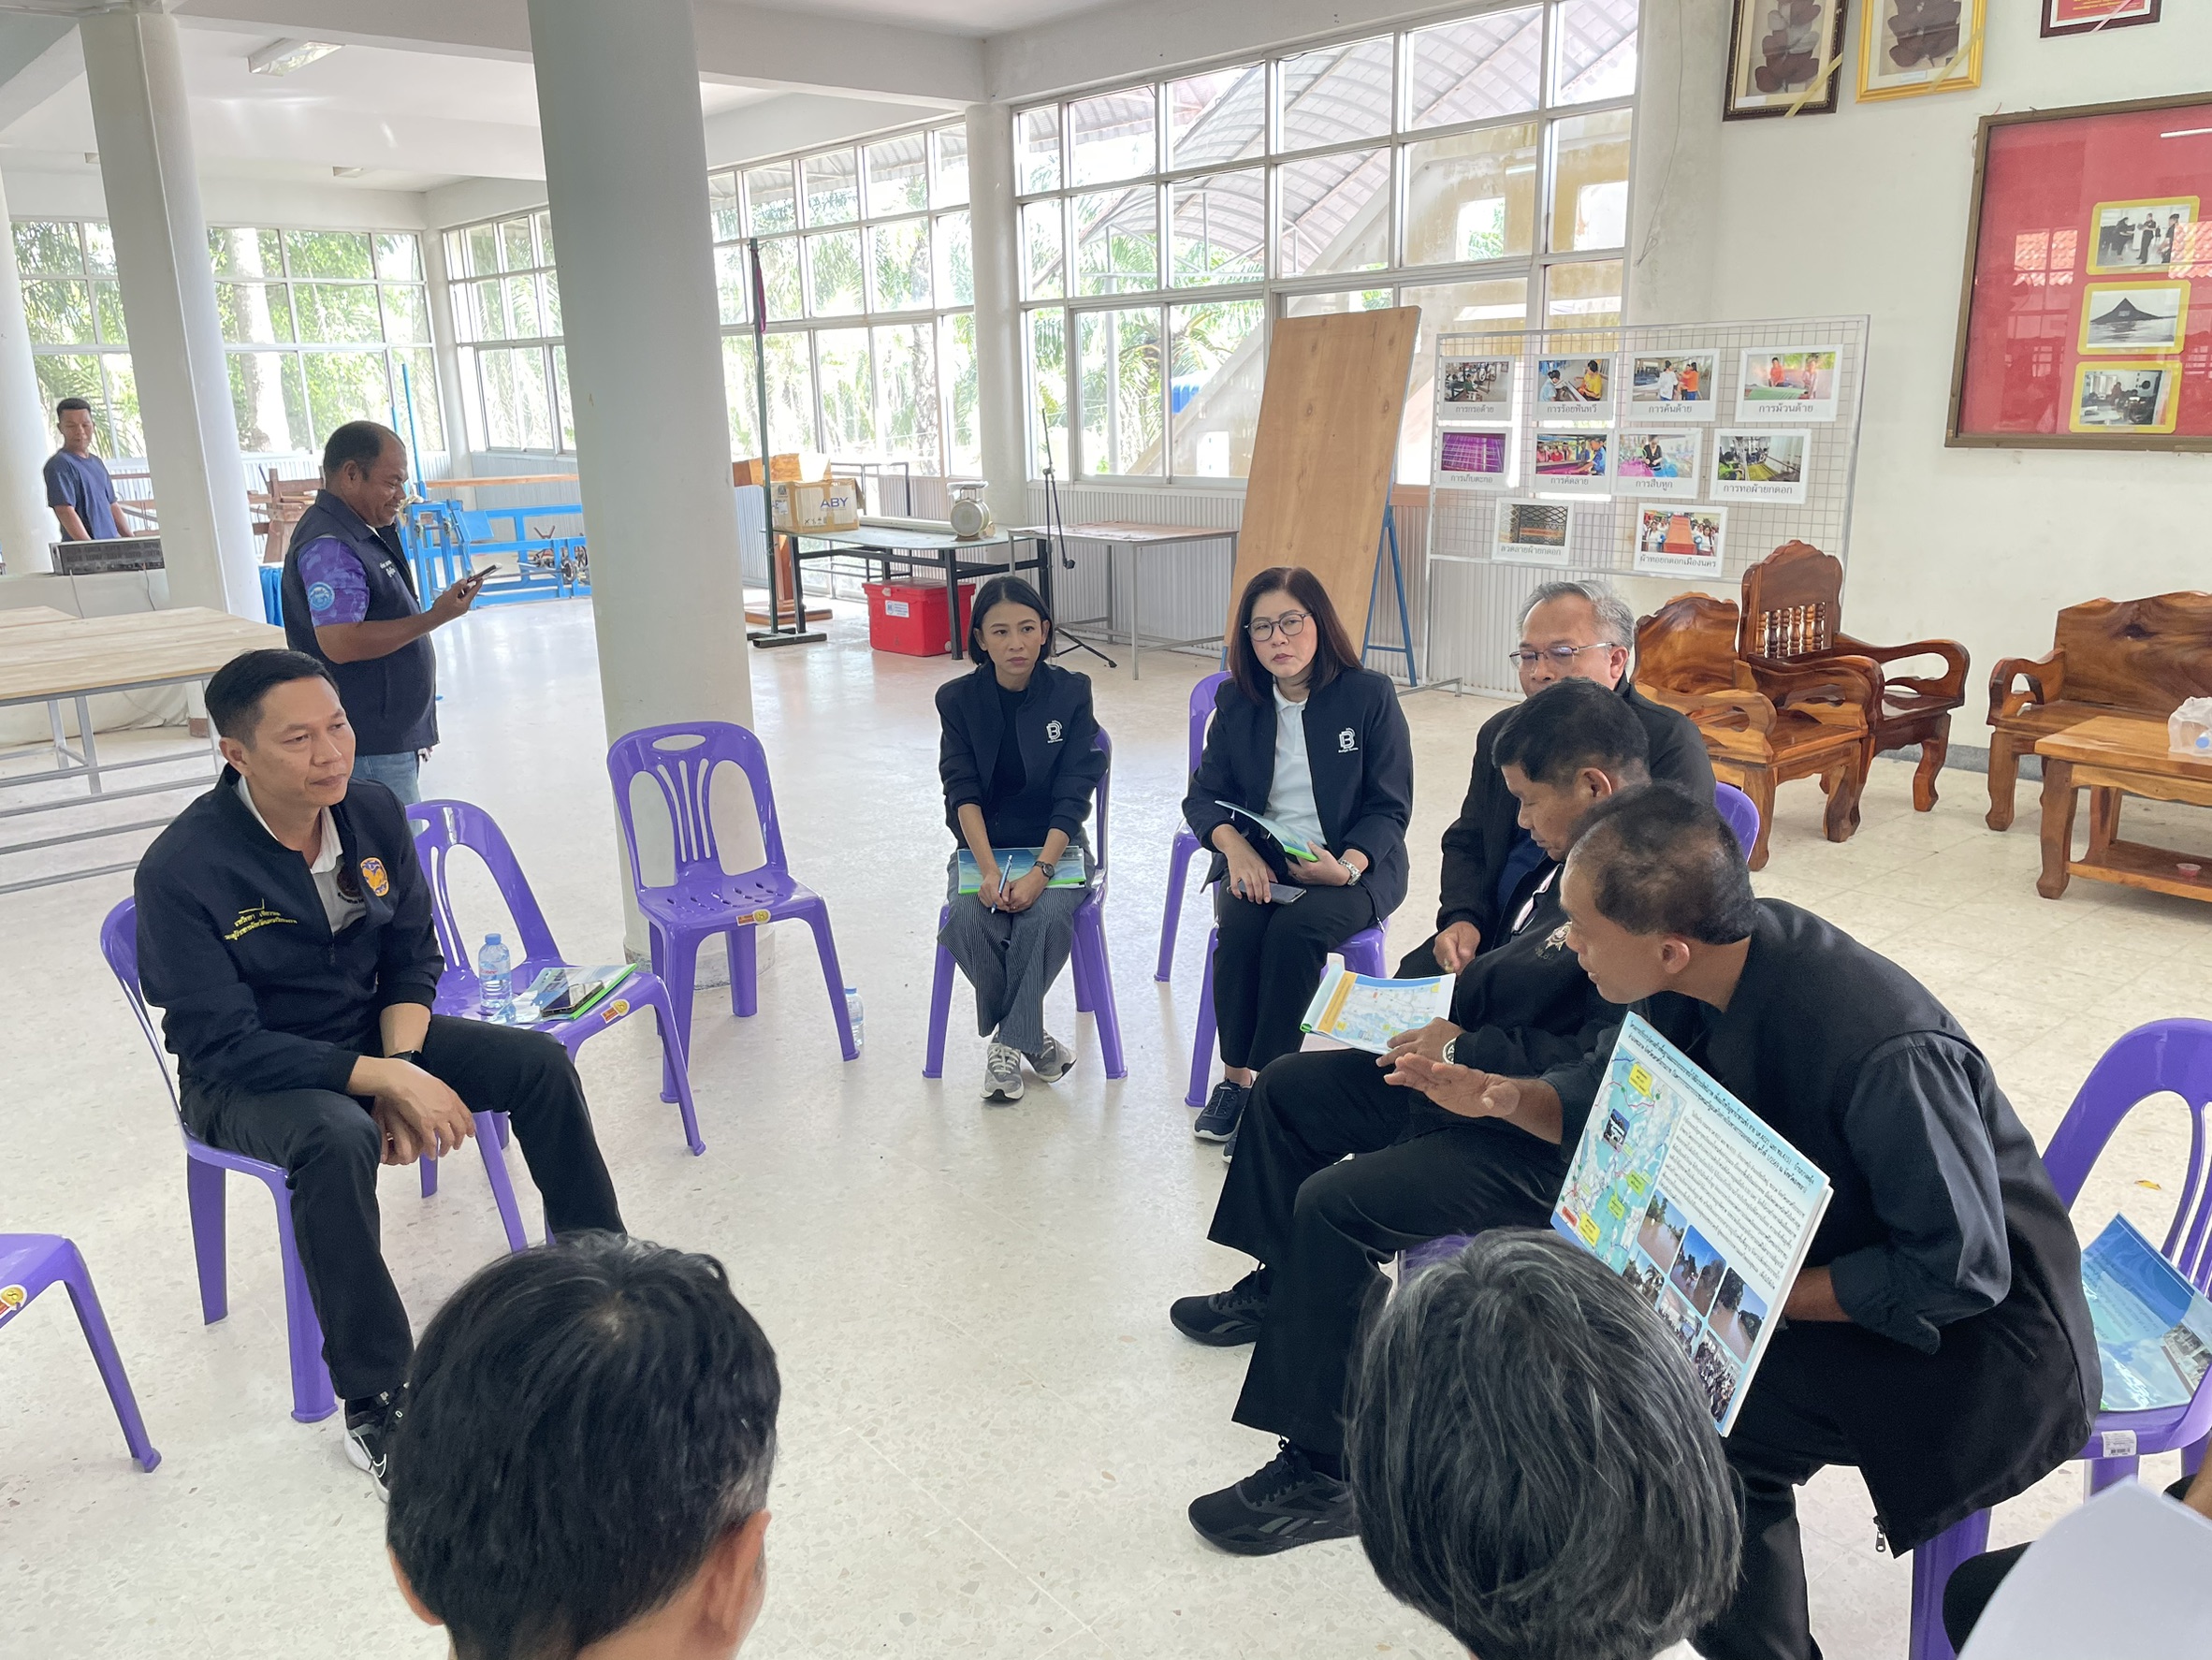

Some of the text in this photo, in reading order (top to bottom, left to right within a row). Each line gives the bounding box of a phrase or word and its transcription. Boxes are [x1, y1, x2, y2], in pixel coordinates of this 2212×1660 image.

[1759, 402, 1813, 413] การม้วนด้าย
[1724, 483, 1793, 495] การทอผ้ายกดอก
[821, 497, 849, 508] ABY
